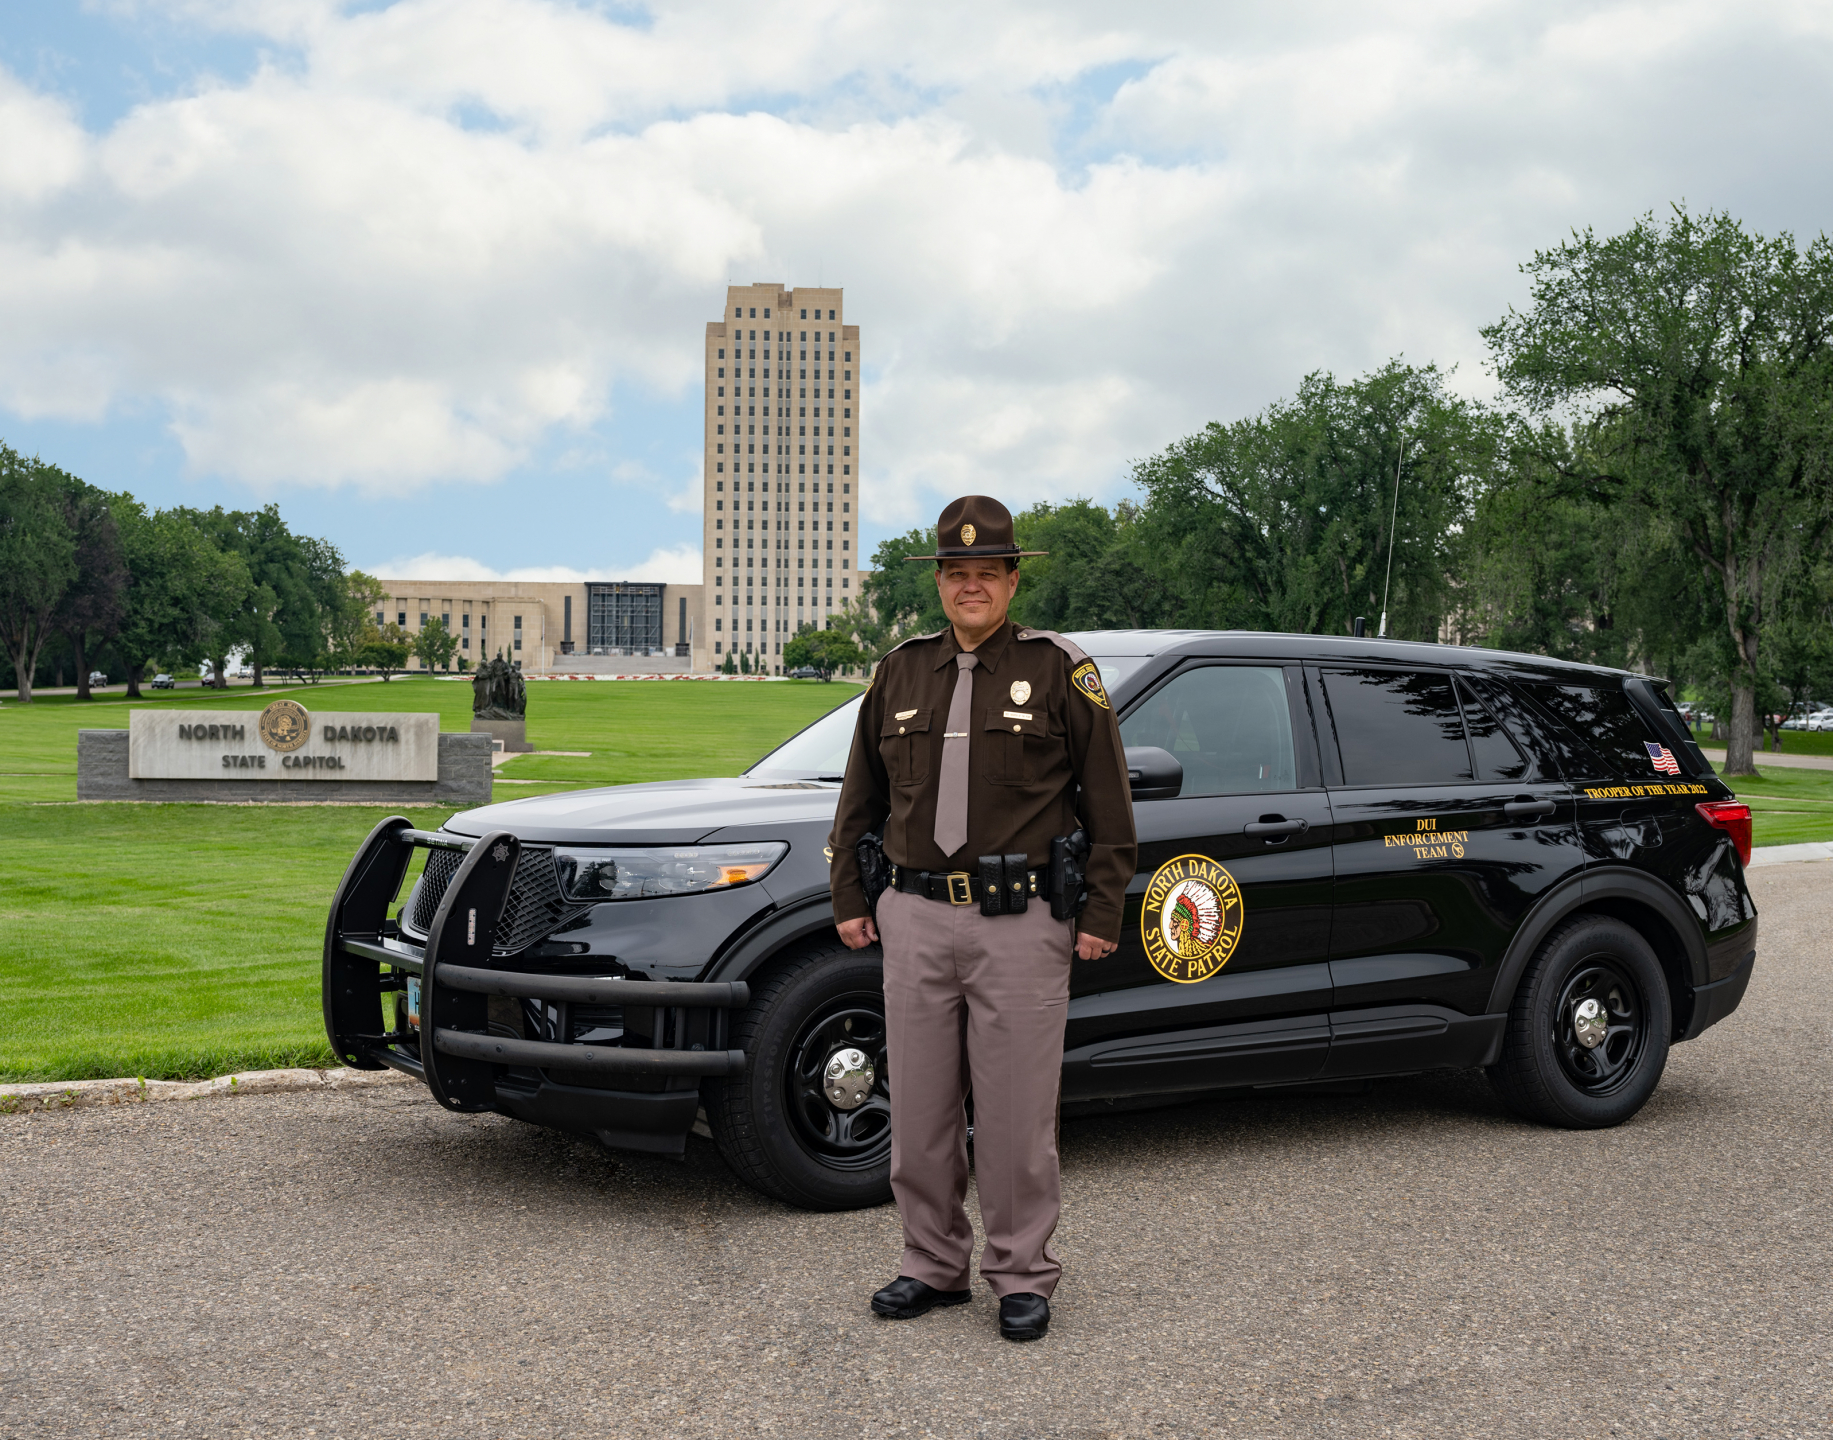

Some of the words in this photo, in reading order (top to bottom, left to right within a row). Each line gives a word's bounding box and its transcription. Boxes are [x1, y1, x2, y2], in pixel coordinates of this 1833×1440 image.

[179, 724, 245, 741] NORTH
[324, 726, 399, 743] DAKOTA
[222, 755, 266, 769] STATE
[281, 755, 346, 771] CAPITOL
[1584, 787, 1633, 799] TROOPER
[1631, 786, 1645, 797] OF
[1644, 785, 1667, 796] THE
[1663, 784, 1691, 795] YEAR
[1688, 784, 1708, 794] 2022
[1416, 818, 1437, 831] DUI
[426, 837, 448, 847] SETINA
[1384, 831, 1469, 847] ENFORCEMENT
[1413, 846, 1448, 859] TEAM
[1147, 861, 1185, 913] NORTH
[1188, 859, 1239, 911] DAKOTA
[1146, 926, 1183, 976] STATE
[1187, 925, 1238, 978] PATROL
